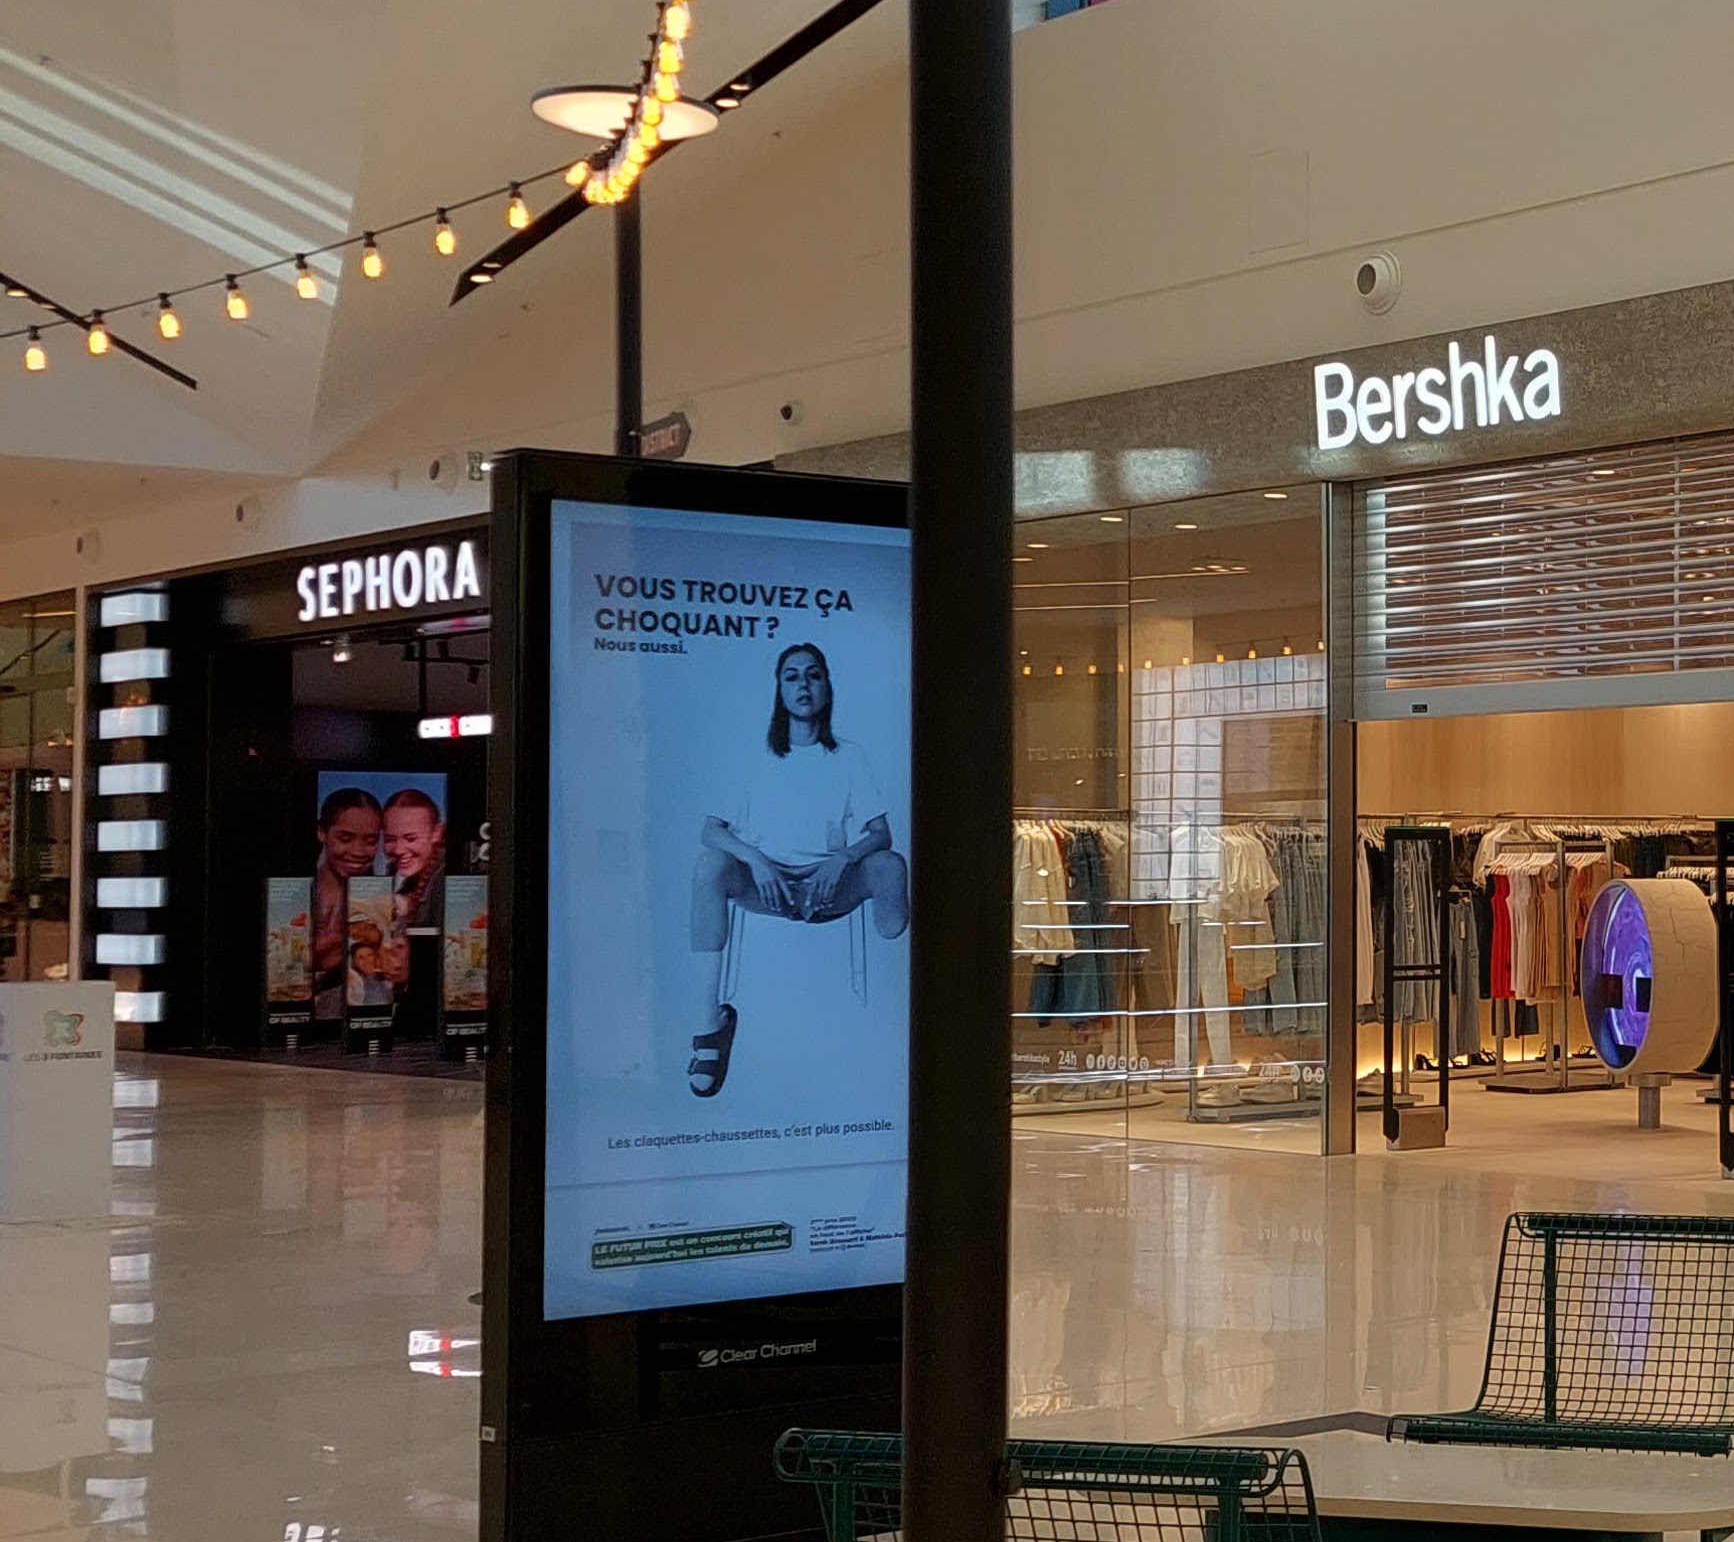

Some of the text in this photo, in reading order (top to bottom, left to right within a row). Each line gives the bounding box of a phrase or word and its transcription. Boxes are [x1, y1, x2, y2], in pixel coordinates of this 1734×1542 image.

[1313, 335, 1562, 449] Bershka
[297, 539, 481, 622] SEPHORA
[594, 574, 853, 618] VOUS TROUVEZ ÇA
[594, 608, 780, 639] CHOQUANT ?
[594, 637, 688, 654] Nous aussi.
[1059, 1050, 1077, 1066] 24h
[608, 1119, 894, 1149] Les claquettes-chaussettes, c'est plus possible.
[720, 1338, 817, 1364] Clear Channel
